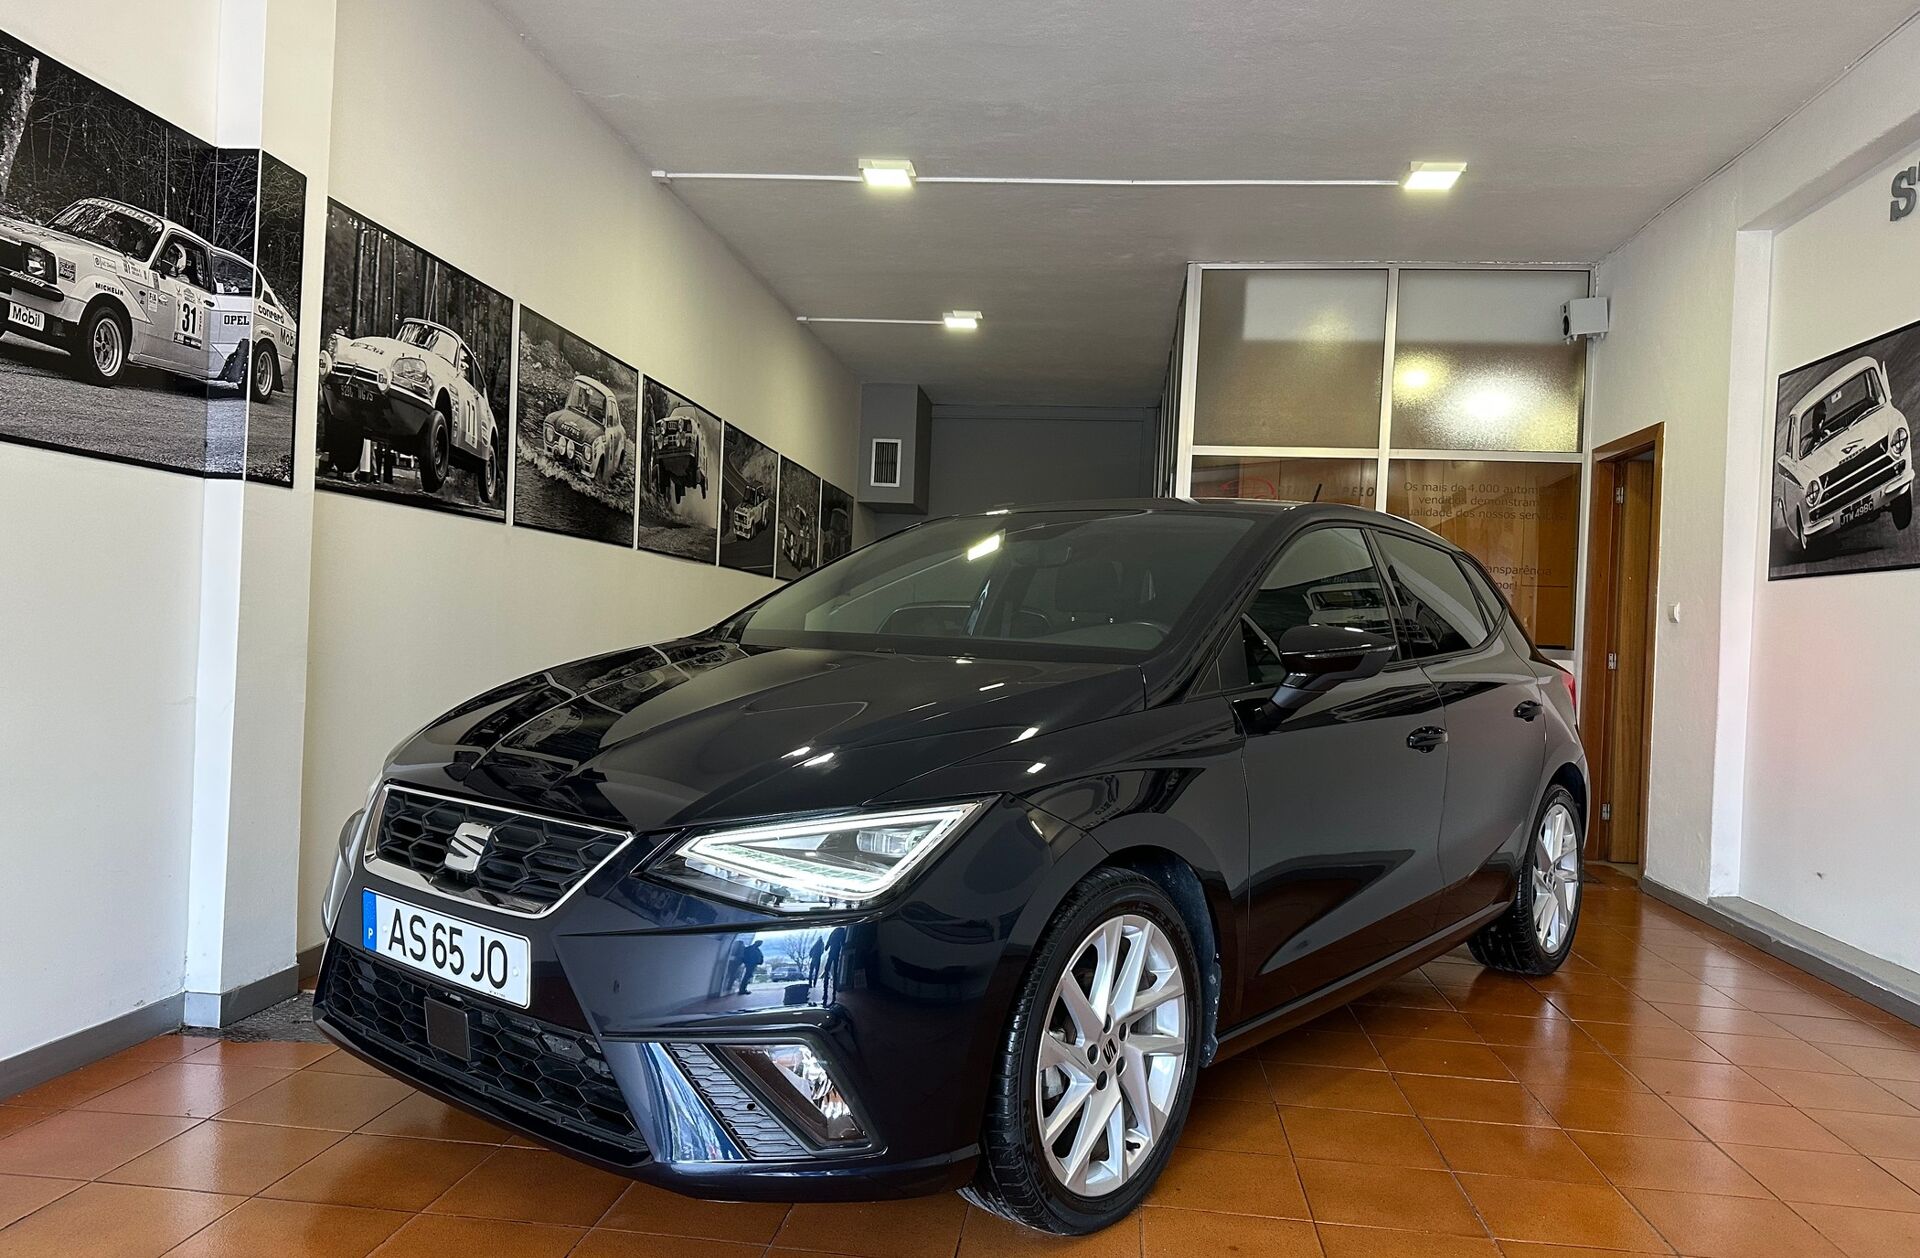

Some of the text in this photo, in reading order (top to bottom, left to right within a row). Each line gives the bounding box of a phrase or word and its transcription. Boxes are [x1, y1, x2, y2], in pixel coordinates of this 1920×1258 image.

[1890, 161, 1920, 221] S
[95, 282, 124, 296] MICHELIN
[12, 305, 40, 327] Mobil
[182, 303, 197, 335] 31
[224, 315, 249, 325] OPEL
[1404, 482, 1418, 492] Os
[1422, 482, 1447, 493] mais
[1451, 482, 1465, 493] de
[1468, 483, 1500, 494] 4.000
[1456, 508, 1476, 518] dos
[1479, 510, 1516, 520] nossos
[1487, 565, 1552, 577] ansparência
[367, 927, 374, 939] P
[388, 908, 508, 989] AS 65 JO
